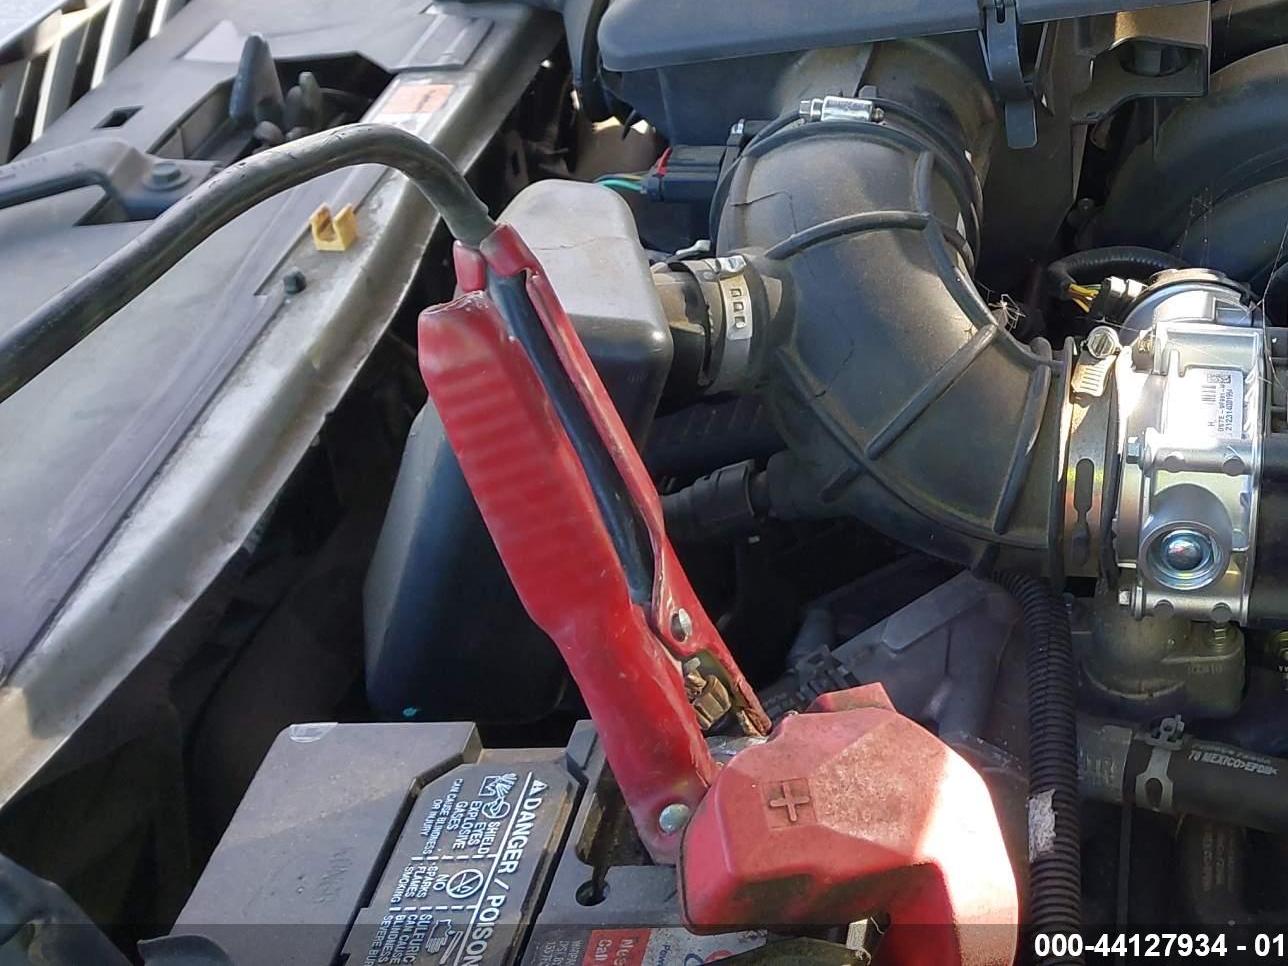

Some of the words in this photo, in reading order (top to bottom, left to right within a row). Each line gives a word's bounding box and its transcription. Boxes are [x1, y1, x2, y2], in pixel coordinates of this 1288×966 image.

[449, 778, 464, 793] CAN
[431, 799, 443, 810] OR
[440, 793, 457, 816] CAUSE
[446, 801, 469, 830] GASES
[420, 811, 438, 836] INJURY
[422, 816, 448, 855] BLINDNESS
[452, 800, 483, 850] EXPLOSIVE
[468, 821, 487, 846] EYES
[478, 821, 501, 855] SHIELD
[497, 798, 542, 874] DANGER
[433, 874, 450, 891] NO
[371, 915, 394, 948] SEVERE
[403, 914, 418, 932] CAN
[460, 895, 506, 966] POISON
[378, 914, 406, 964] BLINDNESS
[390, 935, 410, 964] CAUSE
[403, 914, 433, 963] SULFURIC
[595, 939, 613, 962] Call
